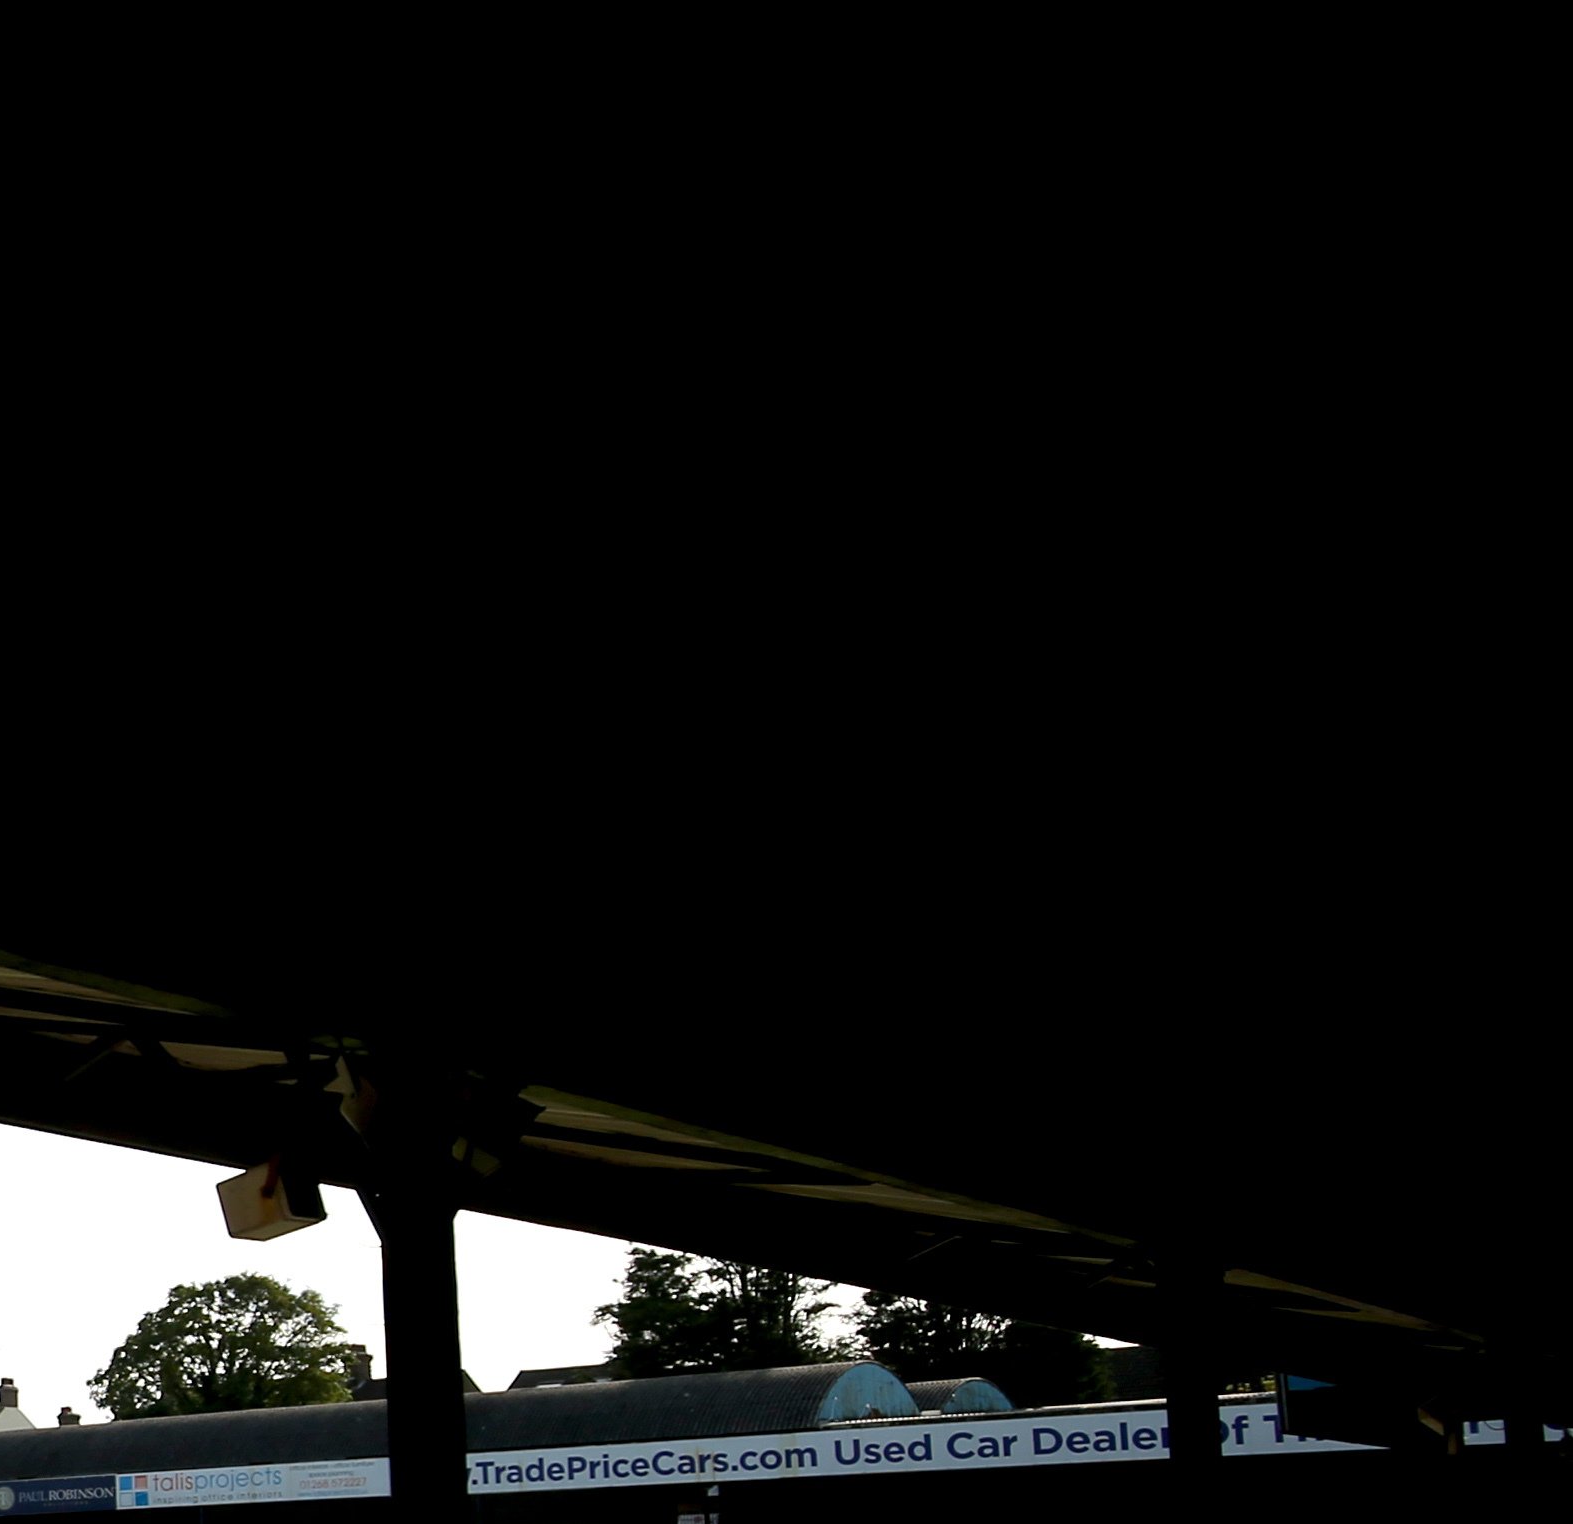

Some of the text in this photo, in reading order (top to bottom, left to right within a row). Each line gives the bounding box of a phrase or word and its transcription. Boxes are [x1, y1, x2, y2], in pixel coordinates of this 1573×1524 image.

[465, 1447, 818, 1485] .TradePriceCars.com
[835, 1434, 932, 1465] Used
[947, 1432, 1018, 1460] Car
[151, 1468, 282, 1494] talisprojects
